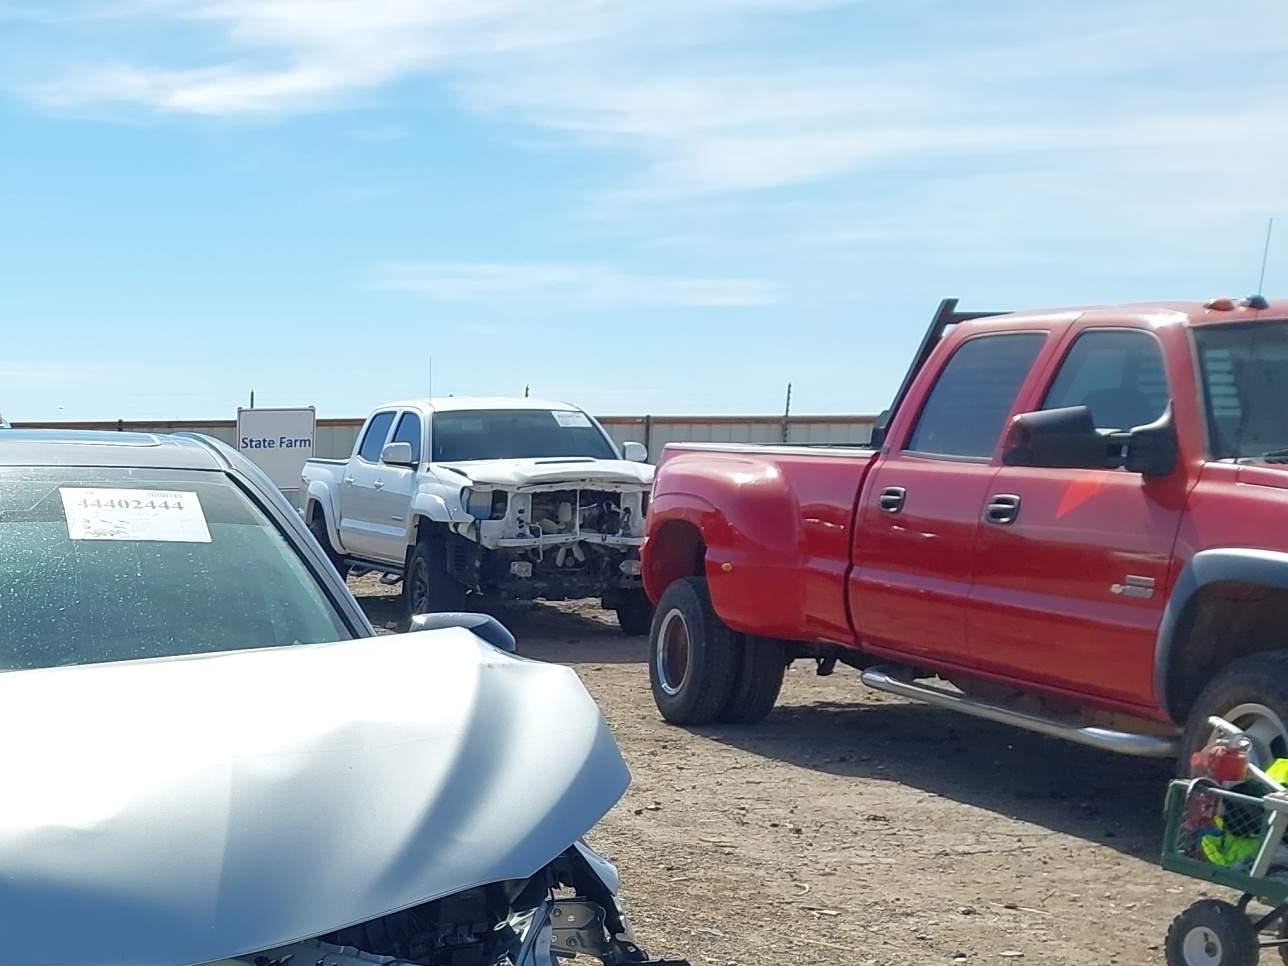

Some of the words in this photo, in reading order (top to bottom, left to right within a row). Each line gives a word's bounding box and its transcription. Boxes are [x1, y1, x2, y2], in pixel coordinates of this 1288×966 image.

[241, 437, 276, 449] State
[279, 436, 312, 449] Farm
[76, 498, 185, 511] 44402444
